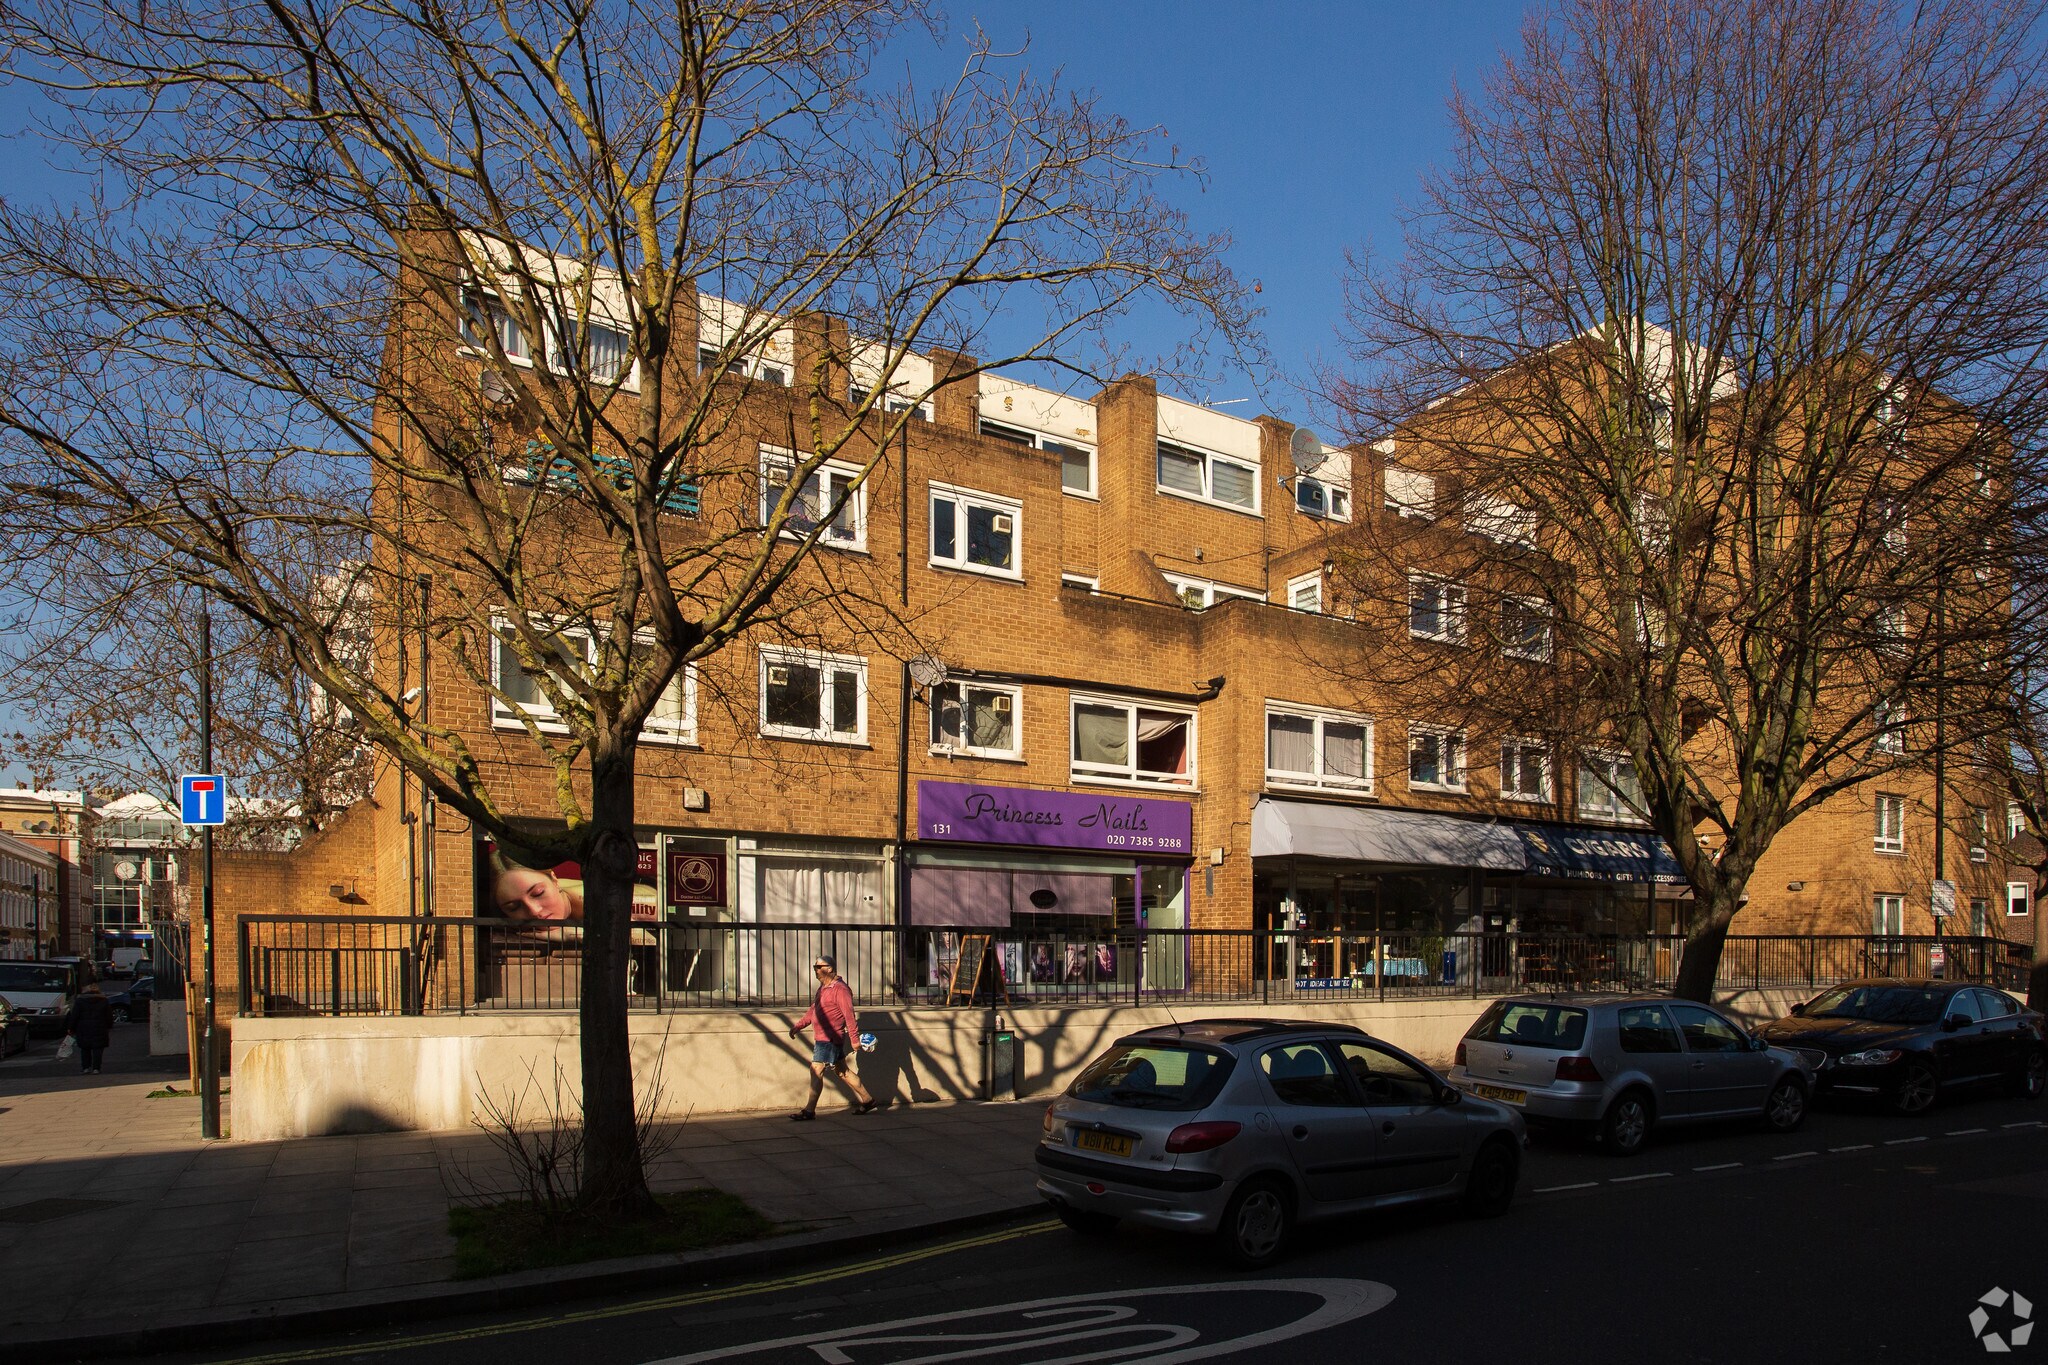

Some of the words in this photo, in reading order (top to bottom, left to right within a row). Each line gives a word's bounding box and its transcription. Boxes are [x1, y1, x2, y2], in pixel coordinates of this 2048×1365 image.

[963, 793, 1063, 826] Princess
[1078, 803, 1148, 831] Nails
[932, 823, 951, 835] 131
[1107, 834, 1125, 845] 020
[1130, 836, 1154, 847] 7385
[1158, 837, 1182, 848] 9288
[1563, 837, 1650, 859] CIGARS
[638, 852, 652, 862] nic
[1539, 866, 1551, 875] 129
[1567, 869, 1602, 880] HUMIDORS
[1616, 872, 1633, 882] GIFTS
[1648, 874, 1687, 884] ACCESSORIES
[632, 903, 656, 916] ility
[1310, 980, 1326, 988] IDEAS
[1103, 1136, 1125, 1153] RLA
